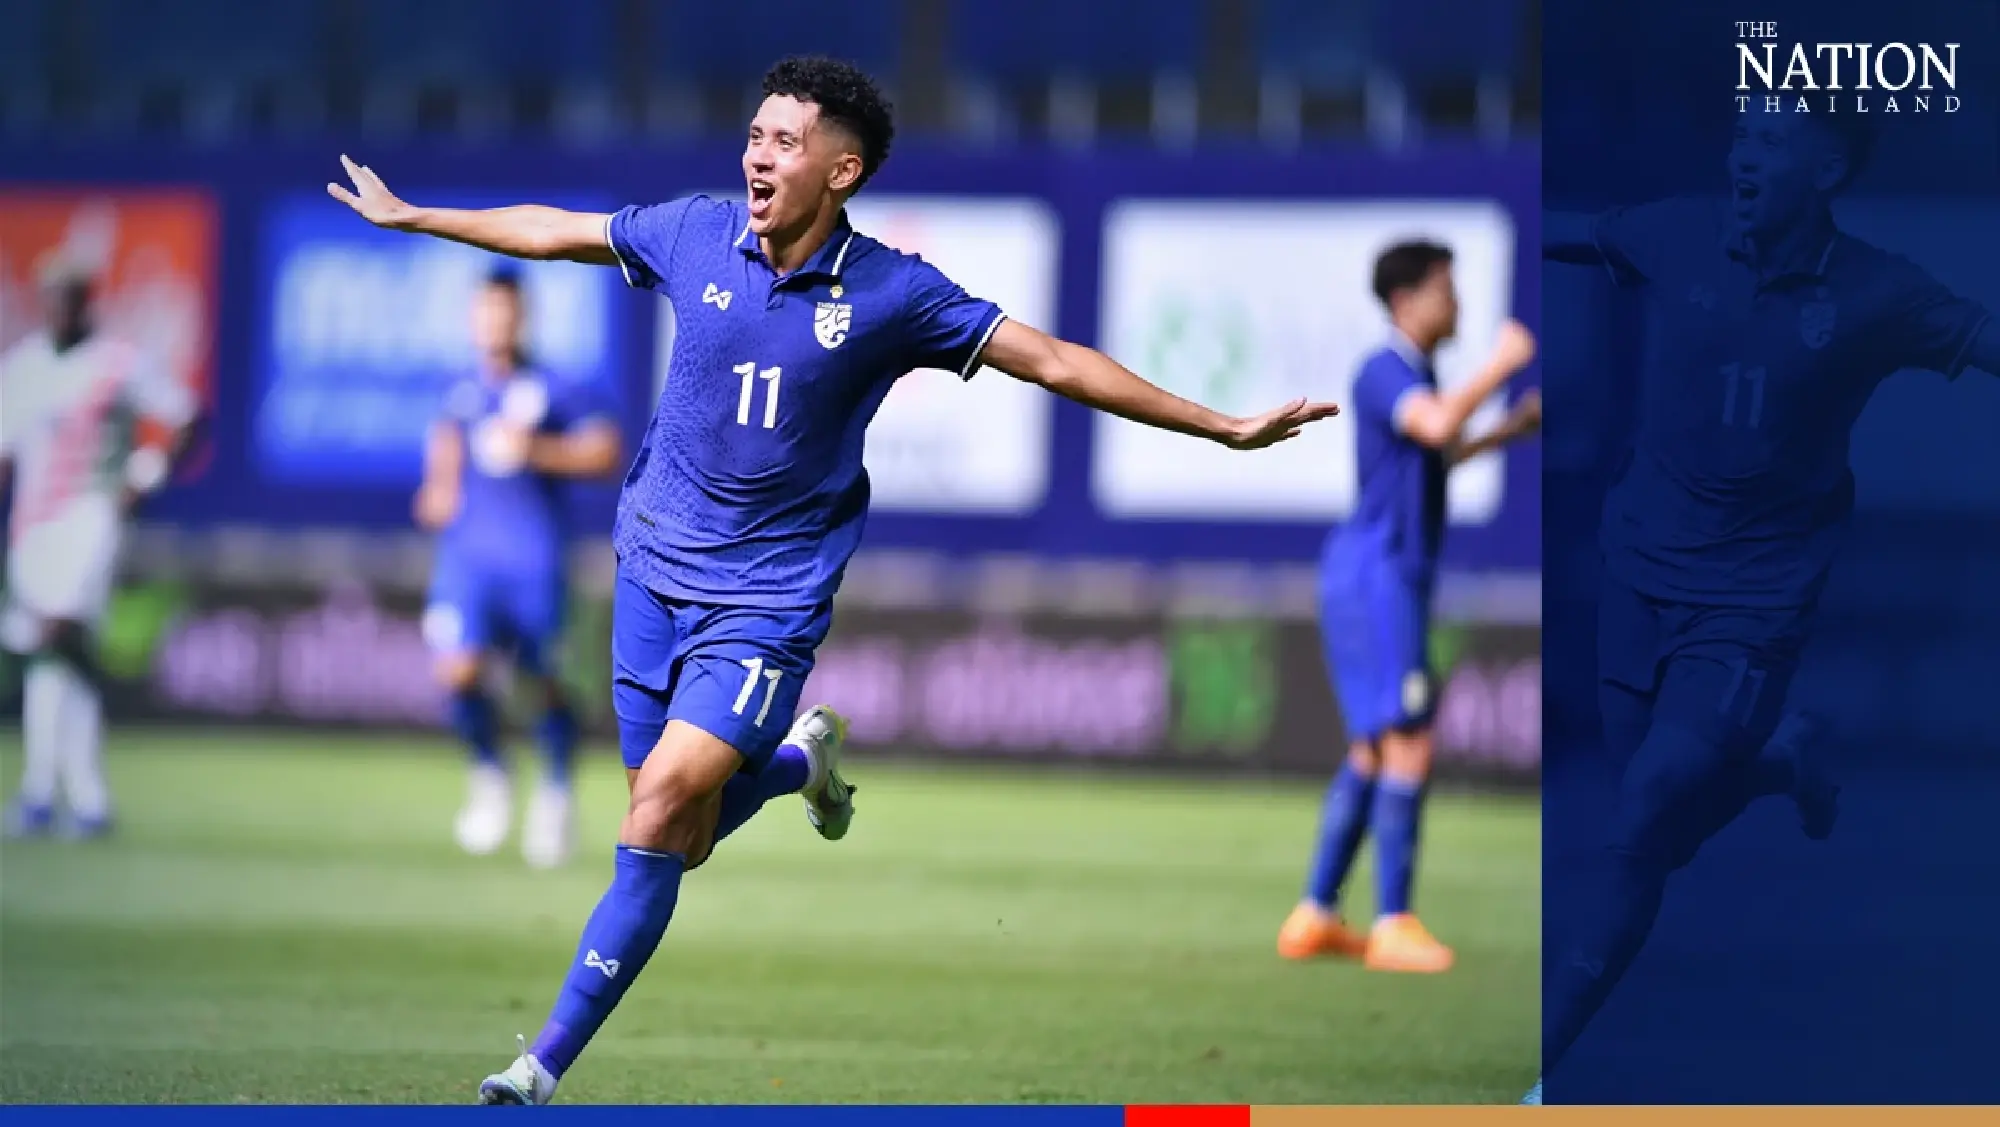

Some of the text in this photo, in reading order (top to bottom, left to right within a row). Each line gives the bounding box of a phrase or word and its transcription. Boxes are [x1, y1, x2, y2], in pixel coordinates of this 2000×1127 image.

[733, 361, 782, 428] 11
[1720, 365, 1766, 428] 11
[732, 657, 783, 727] 11
